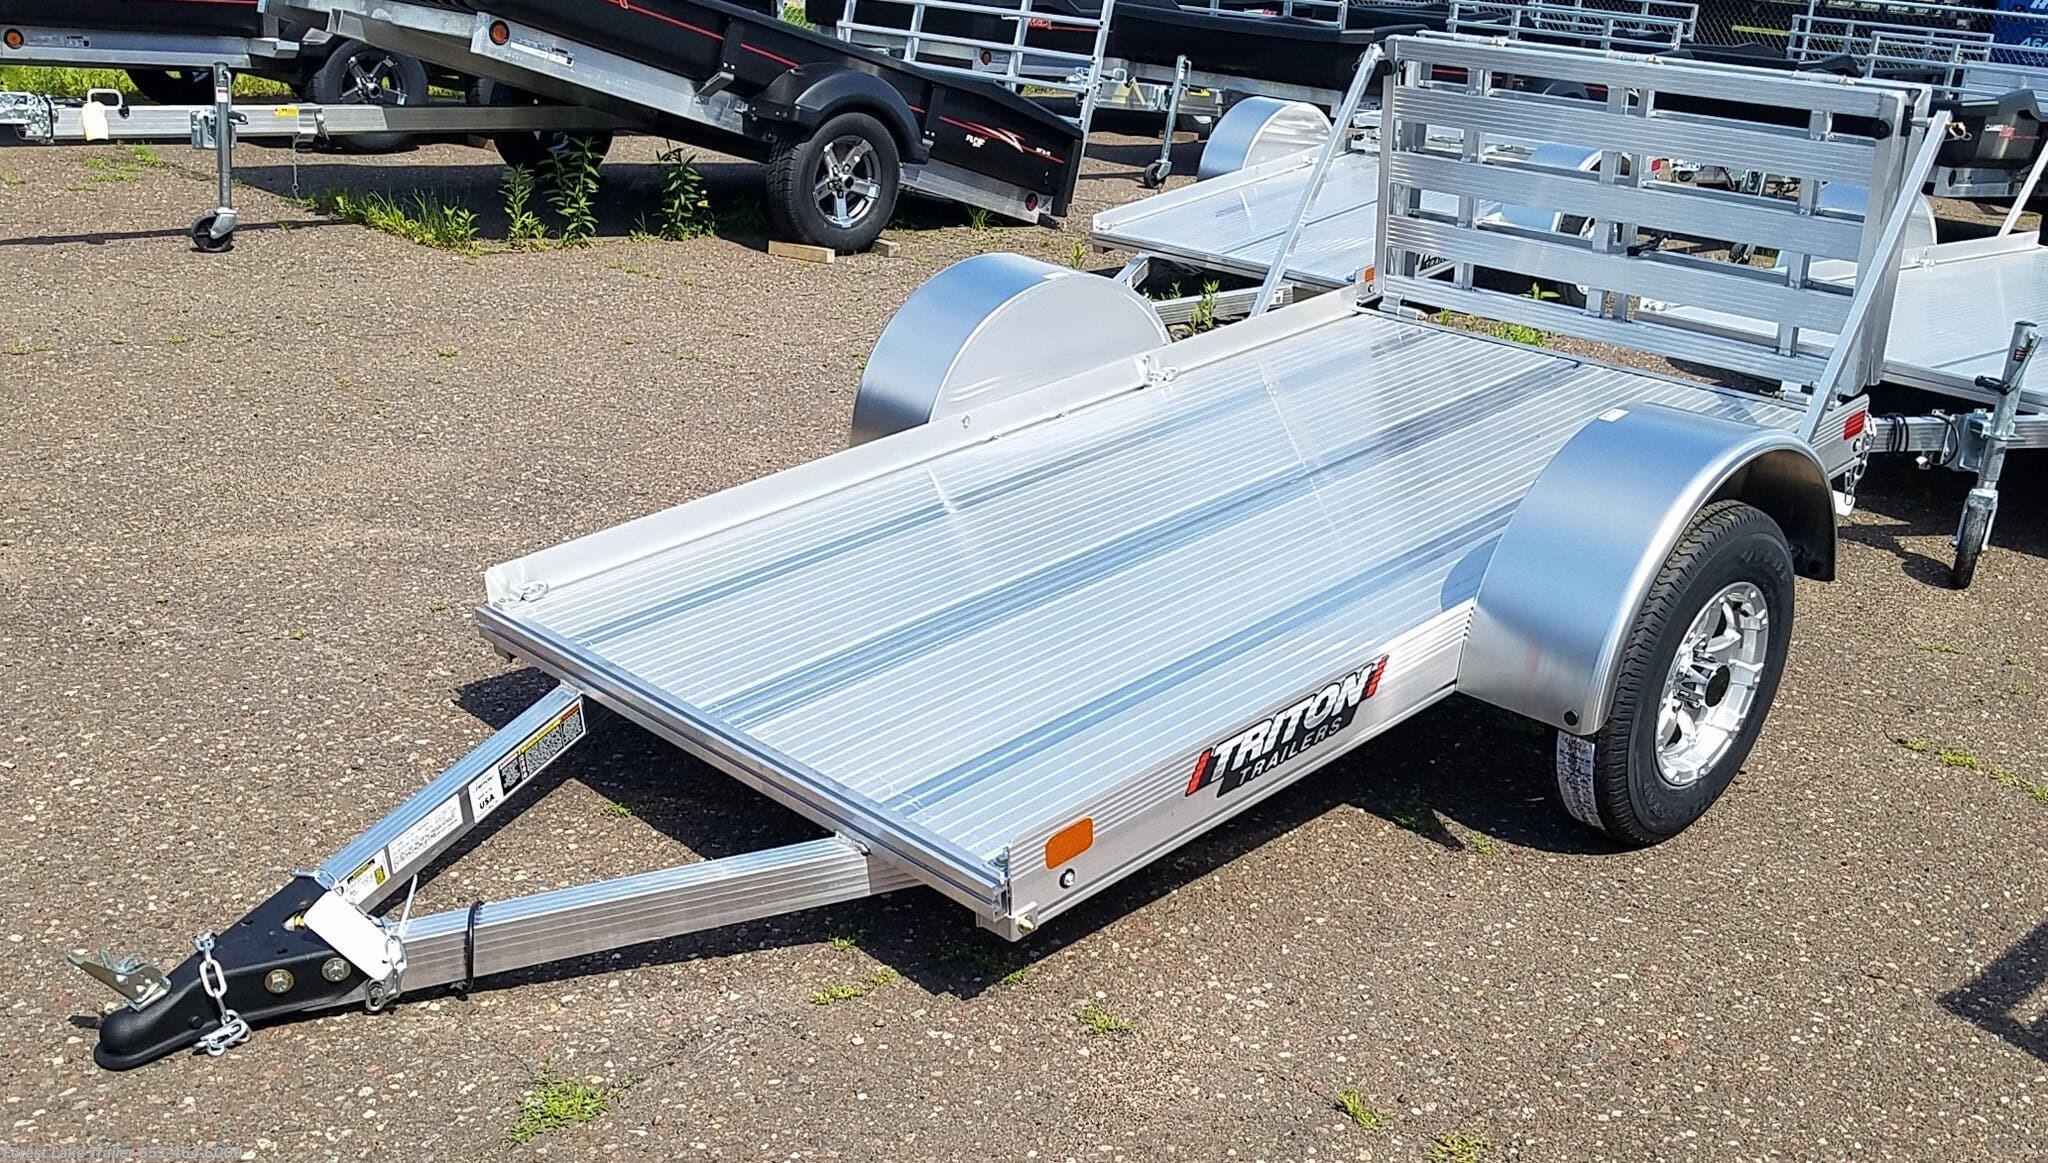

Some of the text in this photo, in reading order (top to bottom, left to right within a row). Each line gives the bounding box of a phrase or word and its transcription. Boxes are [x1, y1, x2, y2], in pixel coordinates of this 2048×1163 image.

[1211, 663, 1374, 783] TRITON
[1239, 716, 1342, 785] TRAILERS
[480, 794, 495, 809] USA
